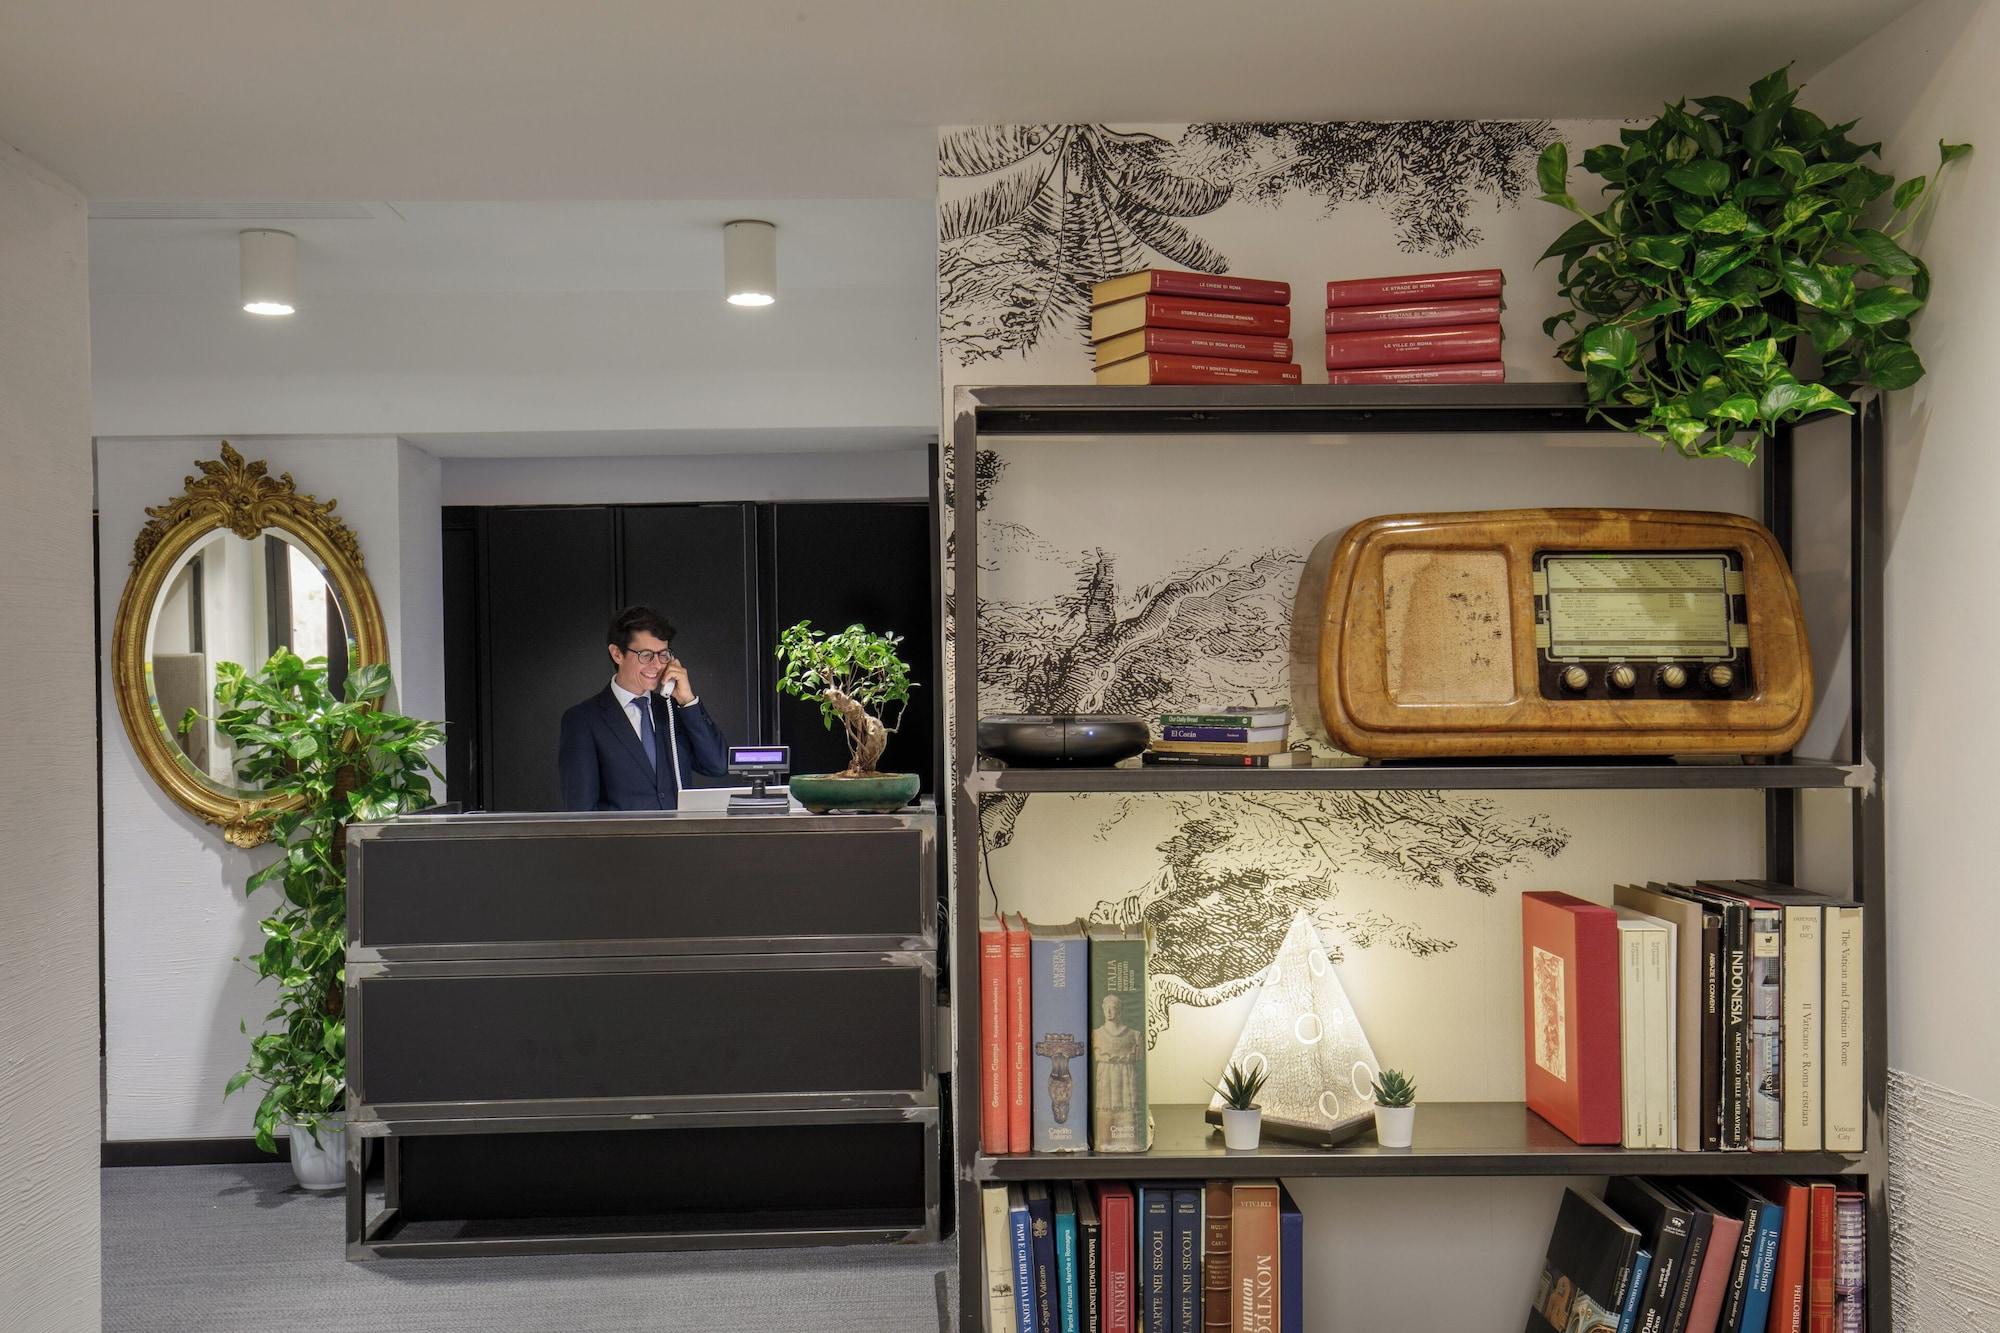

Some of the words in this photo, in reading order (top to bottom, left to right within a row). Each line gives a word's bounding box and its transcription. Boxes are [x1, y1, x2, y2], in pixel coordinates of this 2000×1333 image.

[1841, 930, 1851, 946] The
[1107, 960, 1116, 992] ITALIA
[1841, 948, 1850, 979] Vatican
[1731, 951, 1744, 1025] INDONESIA
[1841, 982, 1850, 997] and
[1802, 1012, 1811, 1050] Vaticano
[1840, 1000, 1850, 1038] Christian
[992, 1044, 1000, 1071] Ciampi
[1016, 1042, 1024, 1070] Ciampi
[1841, 1041, 1850, 1067] Rome
[1802, 1061, 1811, 1087] Roma
[1801, 1090, 1811, 1126] cristiana
[1838, 1132, 1851, 1142] City
[1017, 1224, 1025, 1242] PAPI
[1744, 1209, 1758, 1243] Deputati
[1153, 1231, 1163, 1270] SECOLI
[1183, 1231, 1192, 1270] SECOLI
[1741, 1245, 1750, 1257] dei
[1019, 1250, 1028, 1285] GIUBILEI
[1634, 1269, 1642, 1288] CHIARA
[1734, 1259, 1747, 1288] Camera
[1760, 1241, 1776, 1292] Simbolismo
[1021, 1286, 1028, 1297] DA
[1153, 1274, 1163, 1293] NEI
[1183, 1274, 1192, 1293] NEI
[1680, 1266, 1694, 1308] MONTECITORIO
[1022, 1298, 1030, 1325] LEONE
[1041, 1300, 1050, 1326] Segreto
[1115, 1272, 1125, 1328] BERNINI
[1628, 1288, 1638, 1312] FRUGONI
[1153, 1297, 1163, 1333] L'ARTE
[1183, 1297, 1192, 1333] L'ARTE
[1642, 1308, 1656, 1333] Dante
